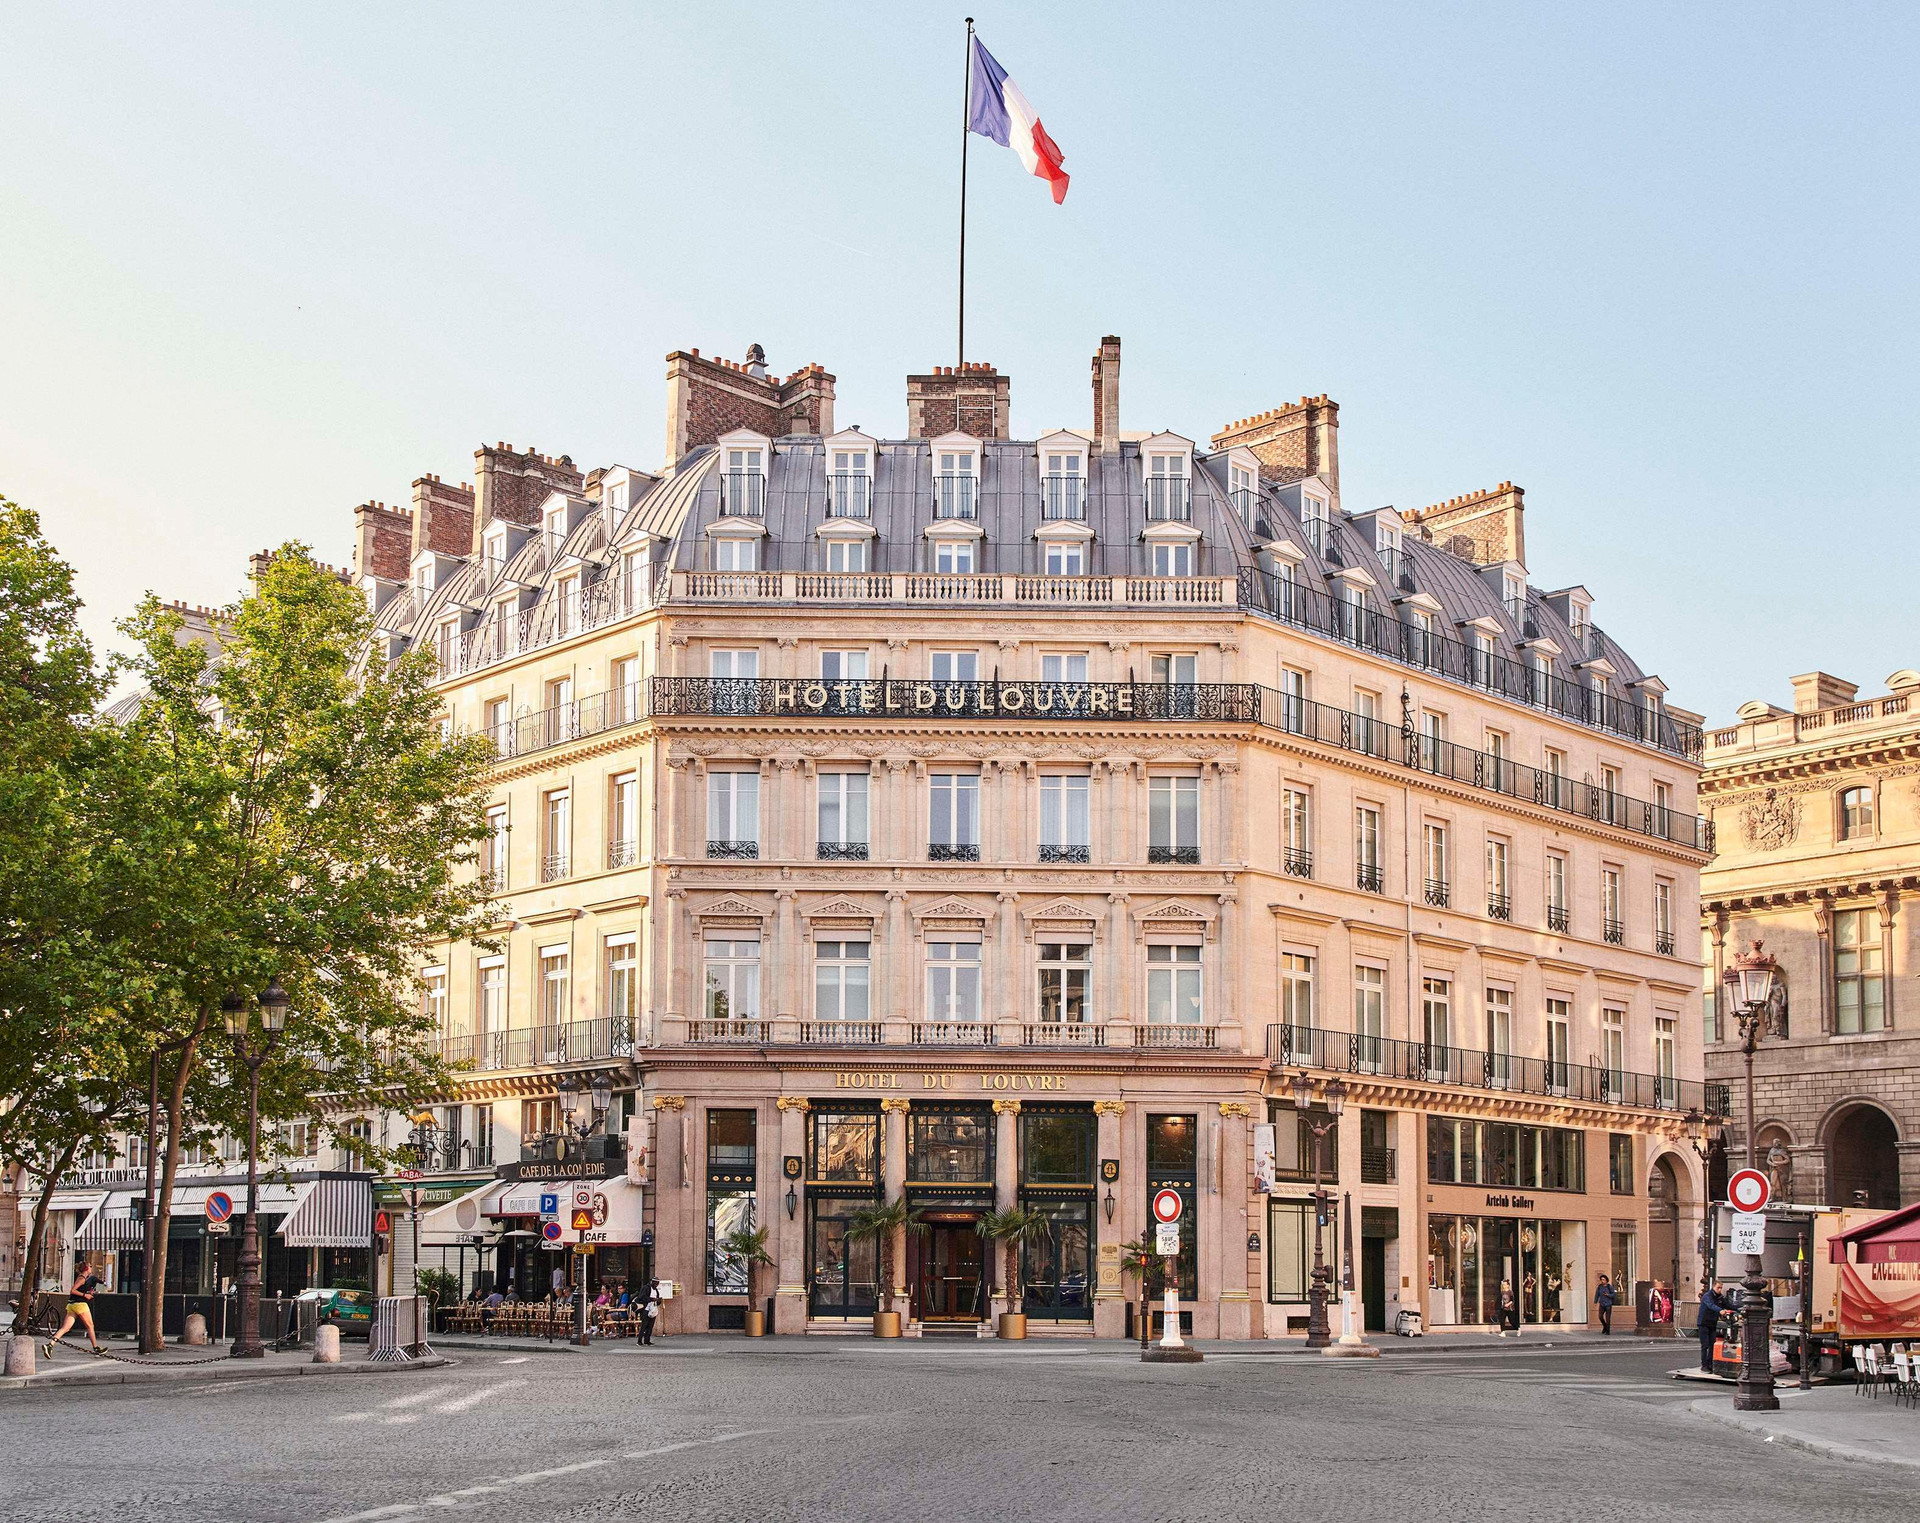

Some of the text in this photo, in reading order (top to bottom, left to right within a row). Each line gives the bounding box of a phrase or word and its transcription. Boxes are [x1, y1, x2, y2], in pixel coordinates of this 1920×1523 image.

[775, 683, 1133, 712] HOTEL DU LOUVRE
[835, 1072, 1067, 1090] HOTEL DU LOUVRE
[89, 1171, 103, 1185] DU
[104, 1169, 141, 1183] LOUVRE
[520, 1166, 540, 1177] CAFE
[541, 1165, 552, 1177] DE
[553, 1164, 566, 1176] LA
[425, 1190, 452, 1200] CIVETTE
[1486, 1193, 1535, 1211] Artclub Gallery
[545, 1198, 553, 1210] P
[585, 1232, 607, 1242] CAFE
